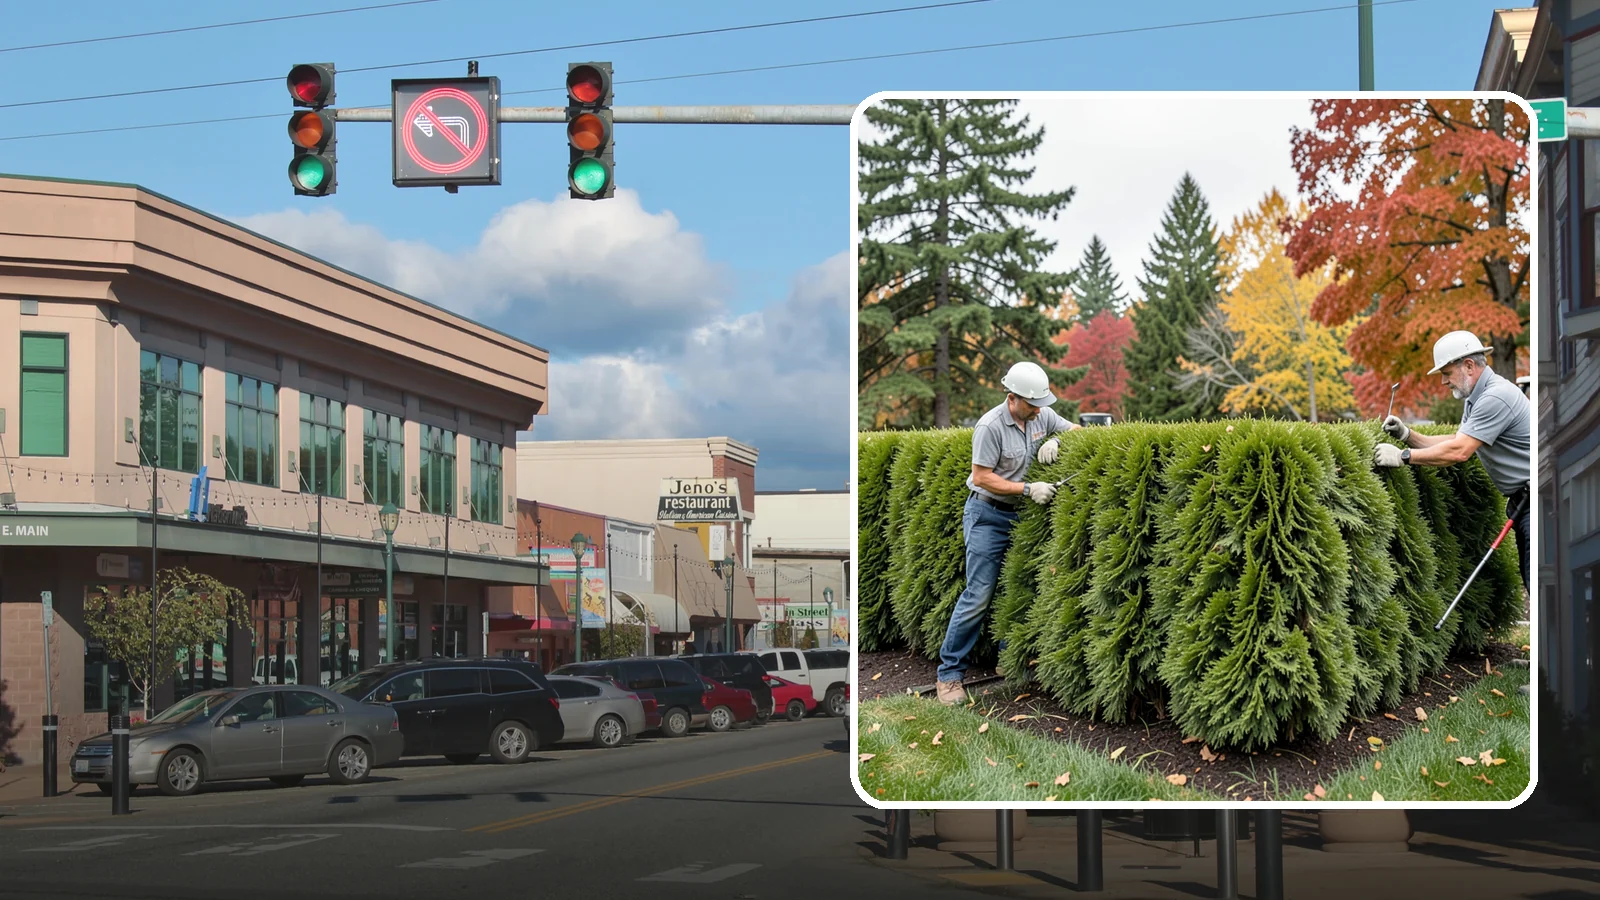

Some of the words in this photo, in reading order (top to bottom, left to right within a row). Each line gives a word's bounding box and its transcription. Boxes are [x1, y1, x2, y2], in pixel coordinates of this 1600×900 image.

[669, 480, 728, 494] Jeno's
[664, 496, 731, 509] restaurant
[658, 510, 682, 520] Italian
[686, 509, 715, 520] American
[715, 509, 738, 519] Cuisine
[2, 525, 13, 536] E.
[15, 525, 49, 536] MAIN
[797, 607, 829, 617] Street
